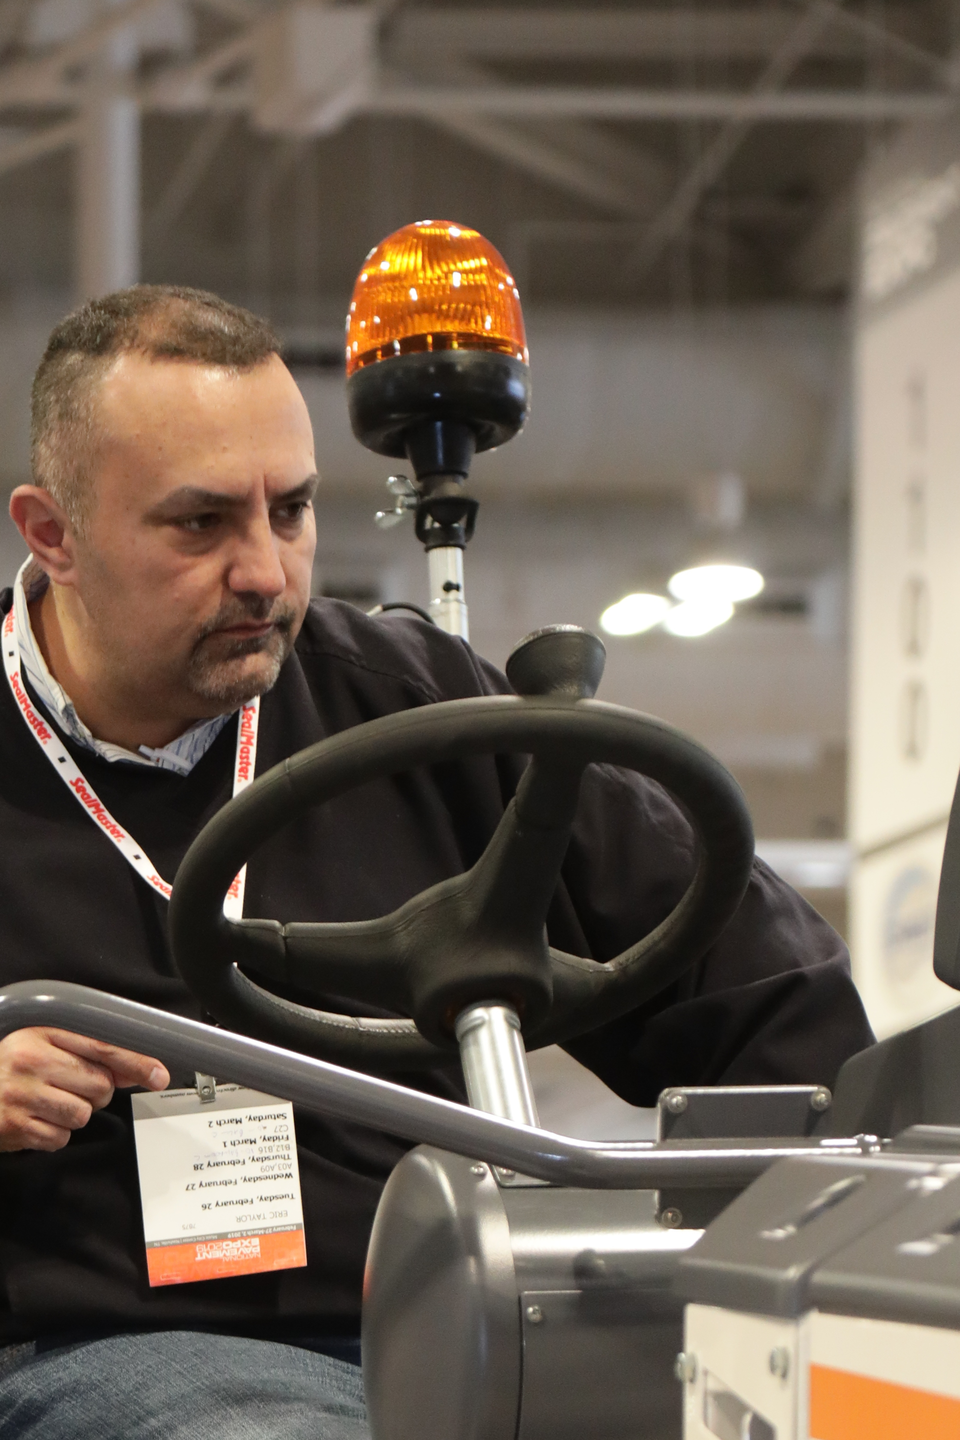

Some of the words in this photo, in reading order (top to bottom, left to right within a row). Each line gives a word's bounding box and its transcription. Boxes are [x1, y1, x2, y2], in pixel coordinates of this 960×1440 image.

[10, 671, 52, 742] SealMaster
[239, 705, 256, 781] SealMaster
[69, 777, 126, 842] SealMaster
[245, 1113, 287, 1122] Saturday,
[229, 1137, 257, 1147] March
[260, 1134, 289, 1143] Friday,
[207, 1158, 245, 1168] February
[248, 1154, 291, 1164] Thursday,
[199, 1178, 237, 1189] February
[240, 1173, 293, 1184] Wednesday,
[215, 1197, 253, 1208] February
[256, 1193, 295, 1203] Tuesday,
[235, 1213, 266, 1222] TAYLOR
[270, 1211, 288, 1219] ERIC
[273, 1225, 296, 1233] February
[196, 1242, 222, 1251] 2019
[222, 1238, 259, 1248] EXPO
[195, 1246, 260, 1260] PAVEMENT
[221, 1253, 260, 1261] NATIONAL
